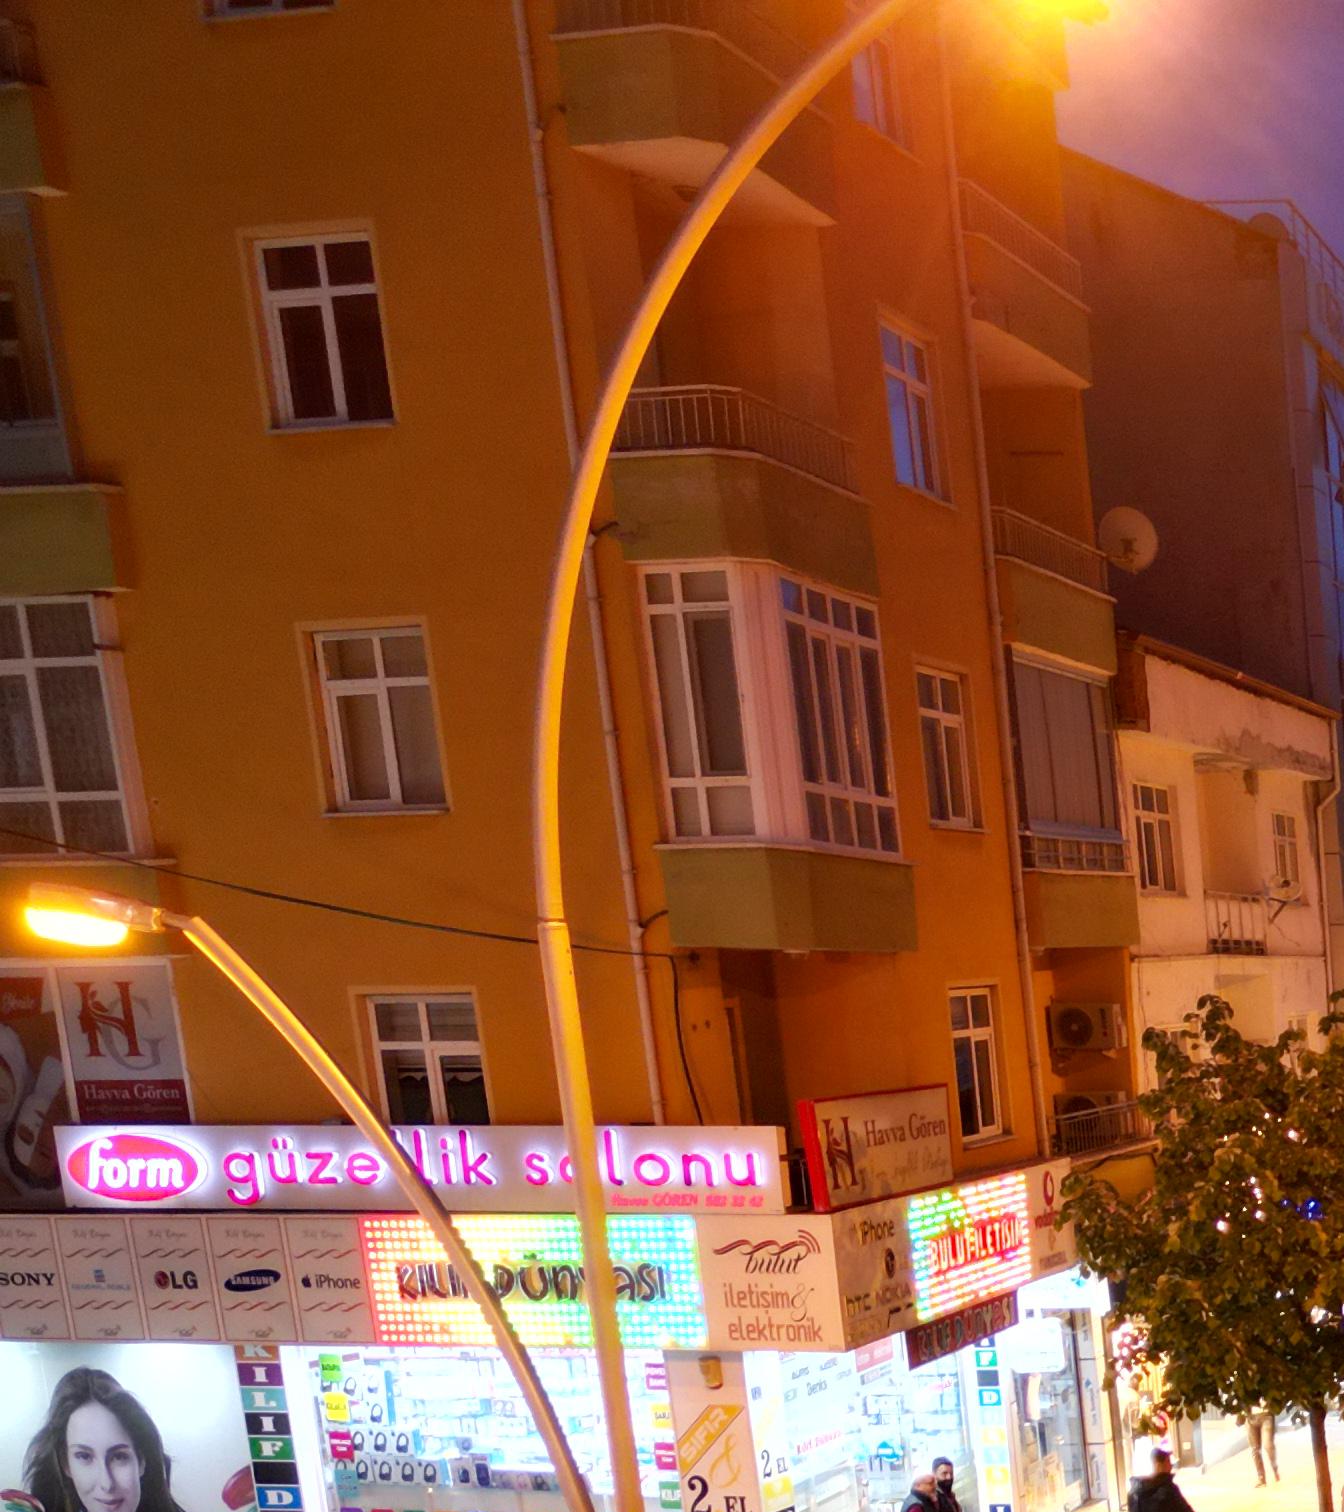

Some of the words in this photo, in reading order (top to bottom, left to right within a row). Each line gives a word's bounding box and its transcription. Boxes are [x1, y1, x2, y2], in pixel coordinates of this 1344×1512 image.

[84, 1083, 130, 1101] Havva
[133, 1082, 180, 1101] Gören
[864, 1119, 906, 1148] Havva
[908, 1112, 946, 1141] Gören
[88, 1138, 185, 1190] form
[652, 1192, 698, 1207] GÖREN
[745, 1251, 801, 1274] bulut
[0, 1271, 55, 1287] SONY
[170, 1271, 198, 1290] LG
[231, 1275, 275, 1285] SAMSUNG
[315, 1273, 361, 1289] iPhone
[723, 1282, 791, 1314] iletişim
[728, 1316, 824, 1342] elektronik
[681, 1407, 728, 1462] SIFIR
[761, 1449, 772, 1479] 2
[776, 1457, 788, 1474] EL
